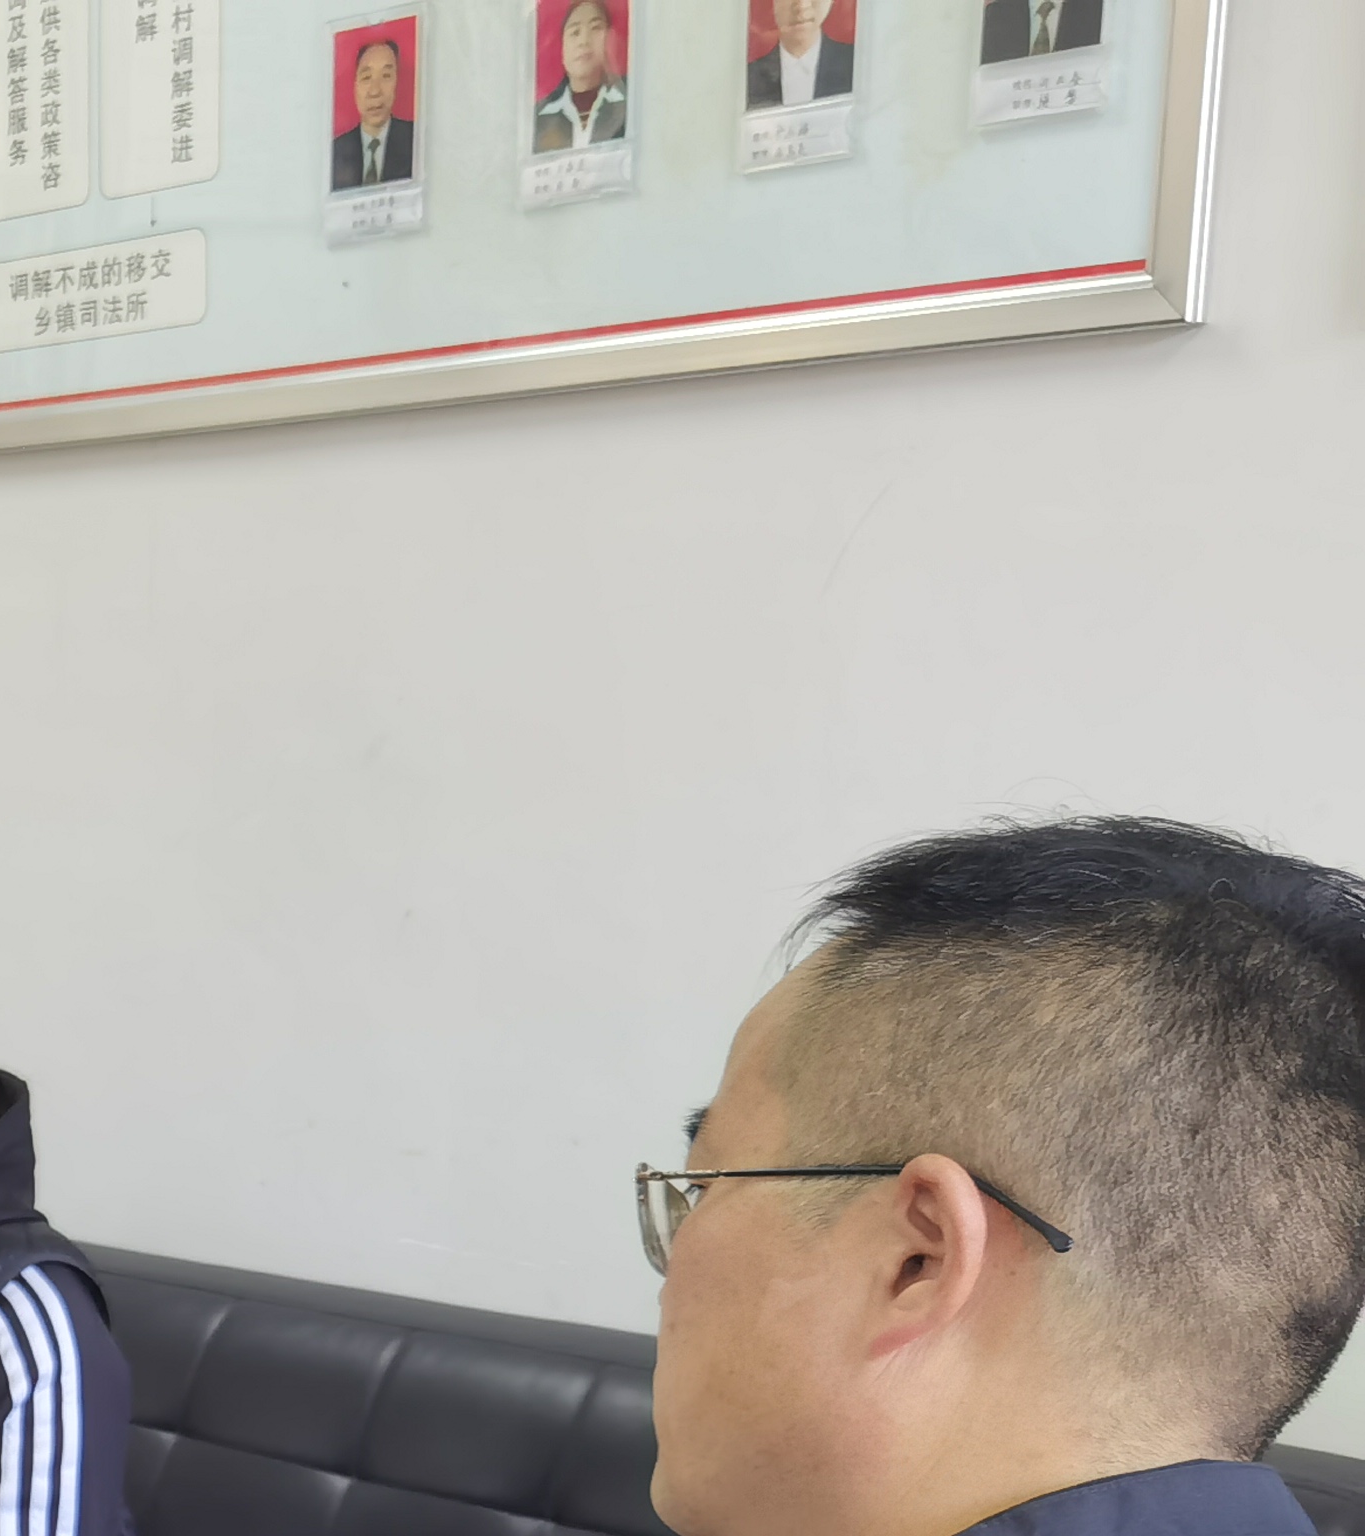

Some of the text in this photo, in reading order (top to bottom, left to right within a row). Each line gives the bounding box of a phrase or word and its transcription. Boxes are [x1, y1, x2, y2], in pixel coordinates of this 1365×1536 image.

[38, 0, 62, 191] 供各类政策咨
[9, 248, 173, 302] 调解不成的移交
[33, 291, 149, 337] 乡镇司法所
